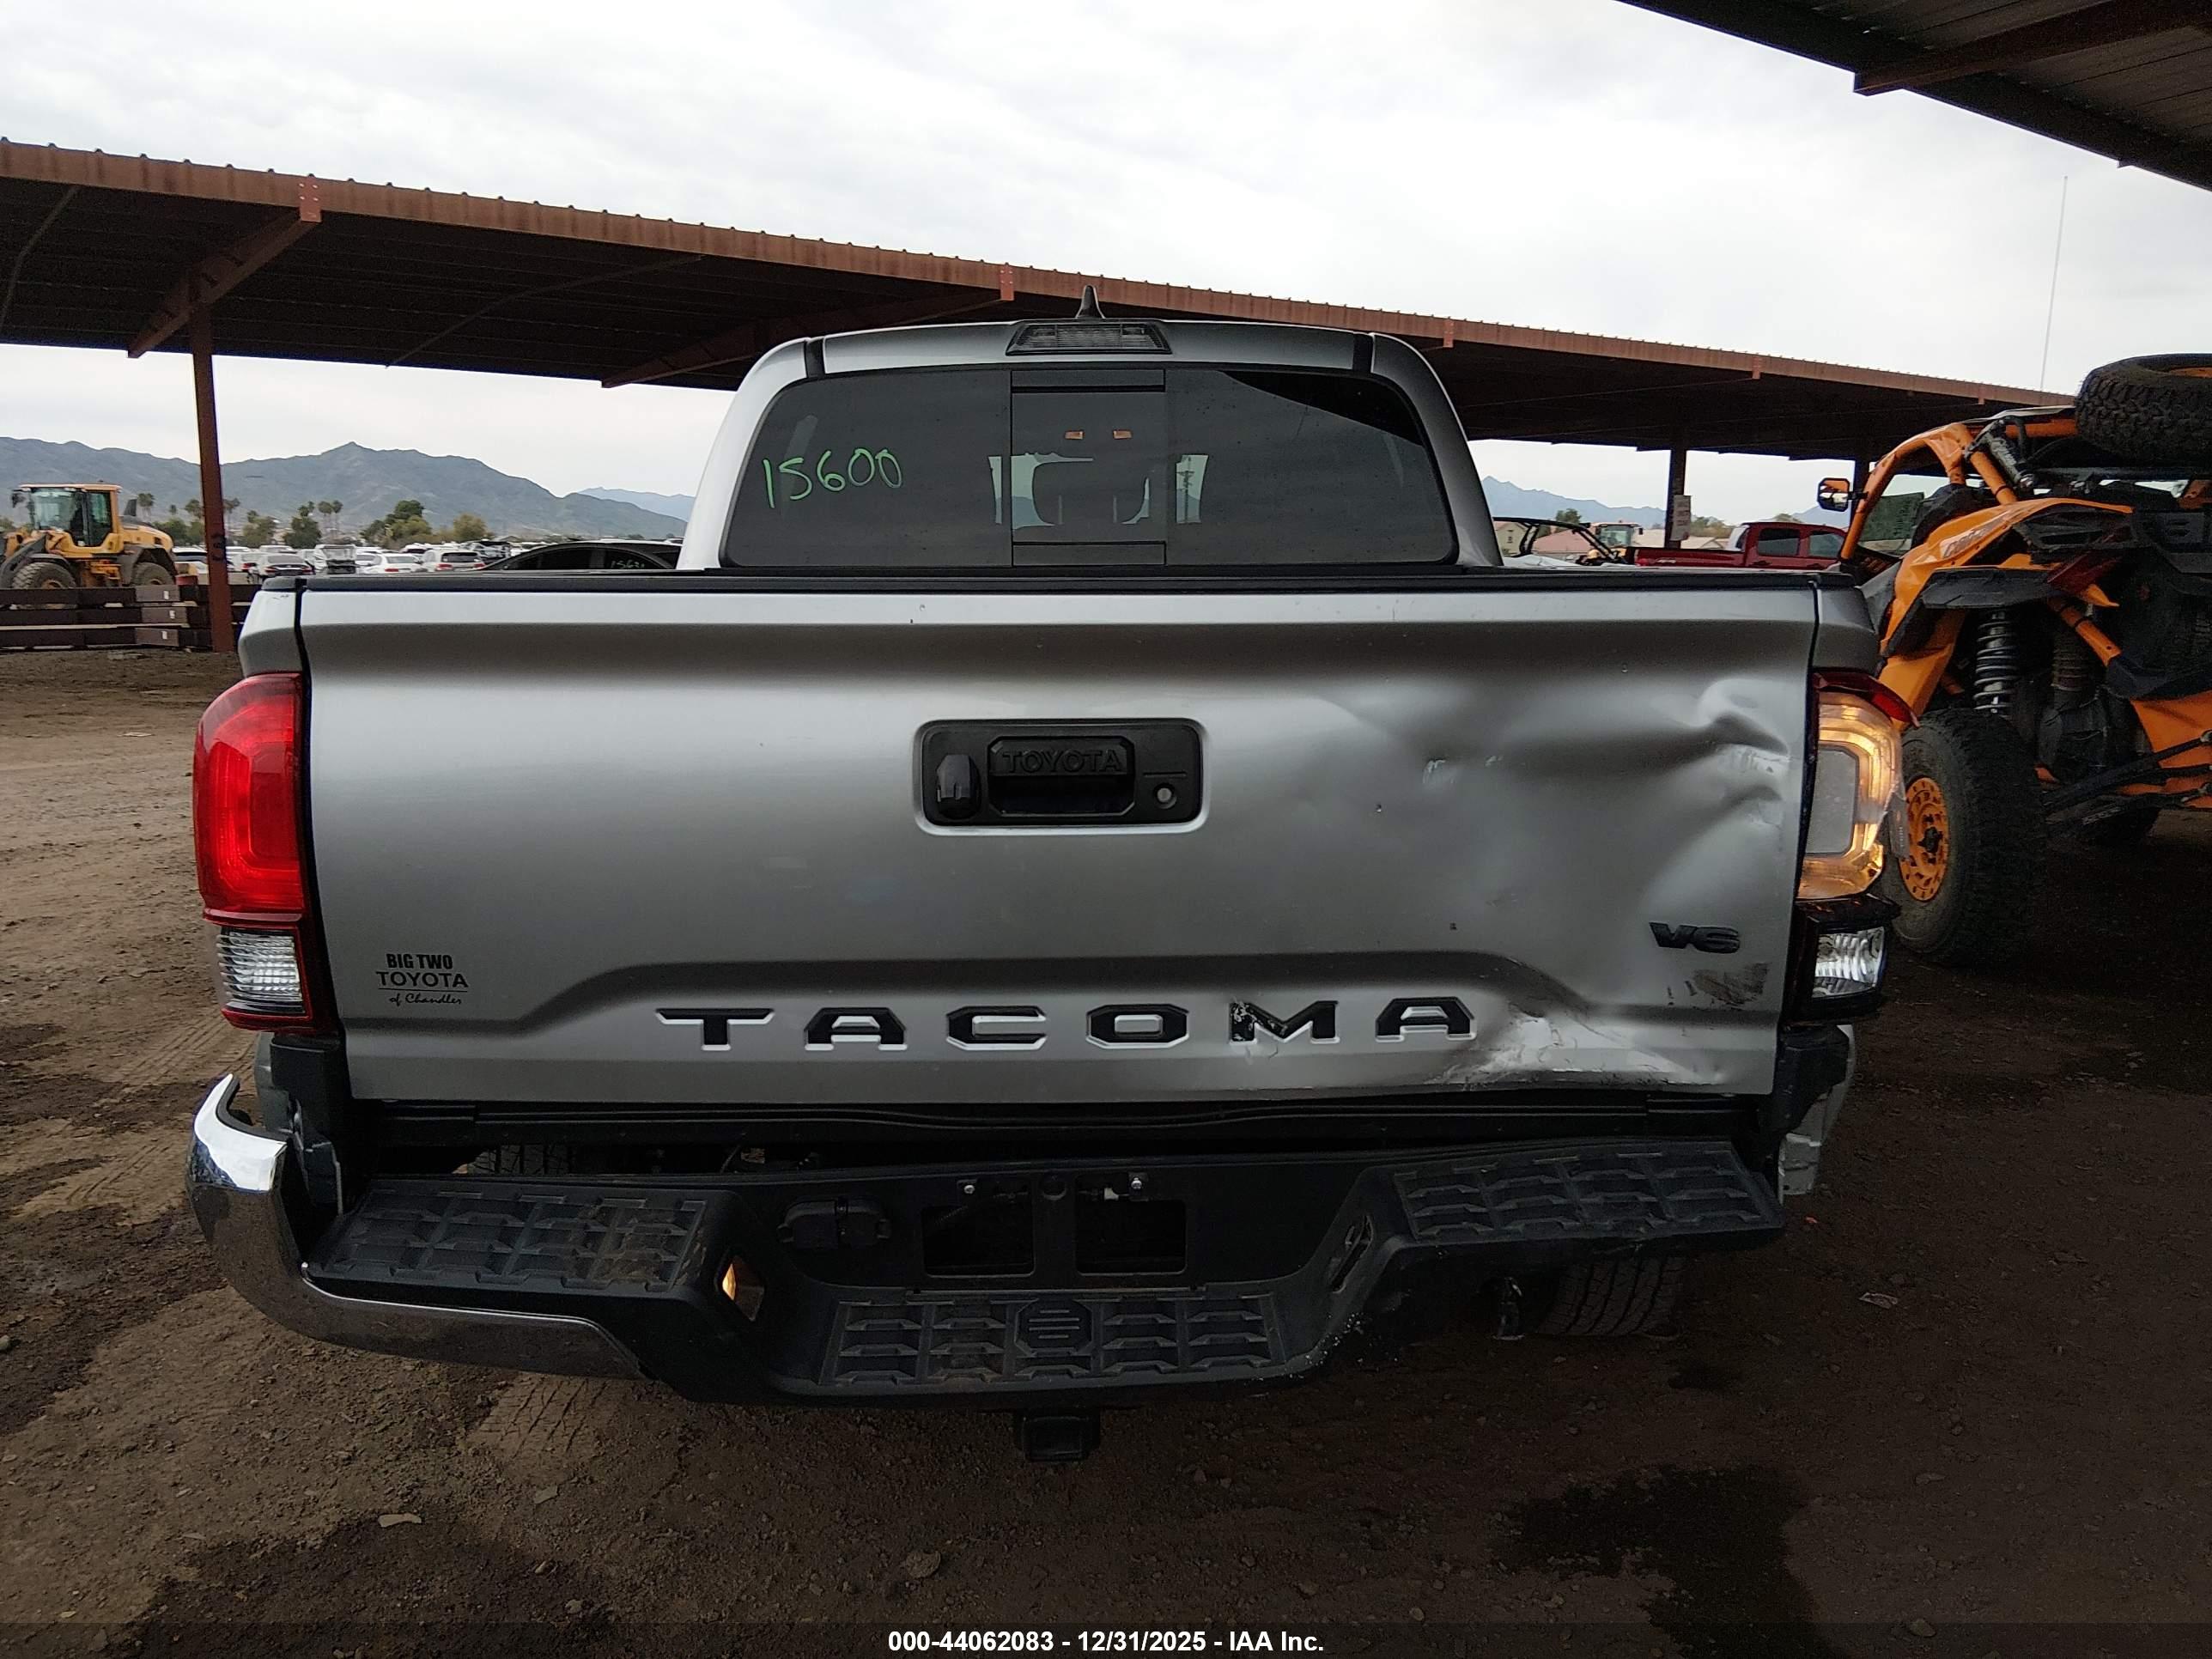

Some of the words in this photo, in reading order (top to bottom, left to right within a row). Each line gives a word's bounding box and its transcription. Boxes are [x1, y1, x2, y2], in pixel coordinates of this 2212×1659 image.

[763, 448, 902, 508] 15600
[1003, 750, 1121, 773] TOYOTA
[1649, 922, 1740, 954] V6
[386, 954, 414, 969] BIG
[416, 954, 453, 969] TWO
[376, 971, 469, 988] TOYOTA
[389, 994, 402, 1006] of
[405, 993, 462, 1005] Chandler
[656, 998, 1477, 1051] TACOMA
